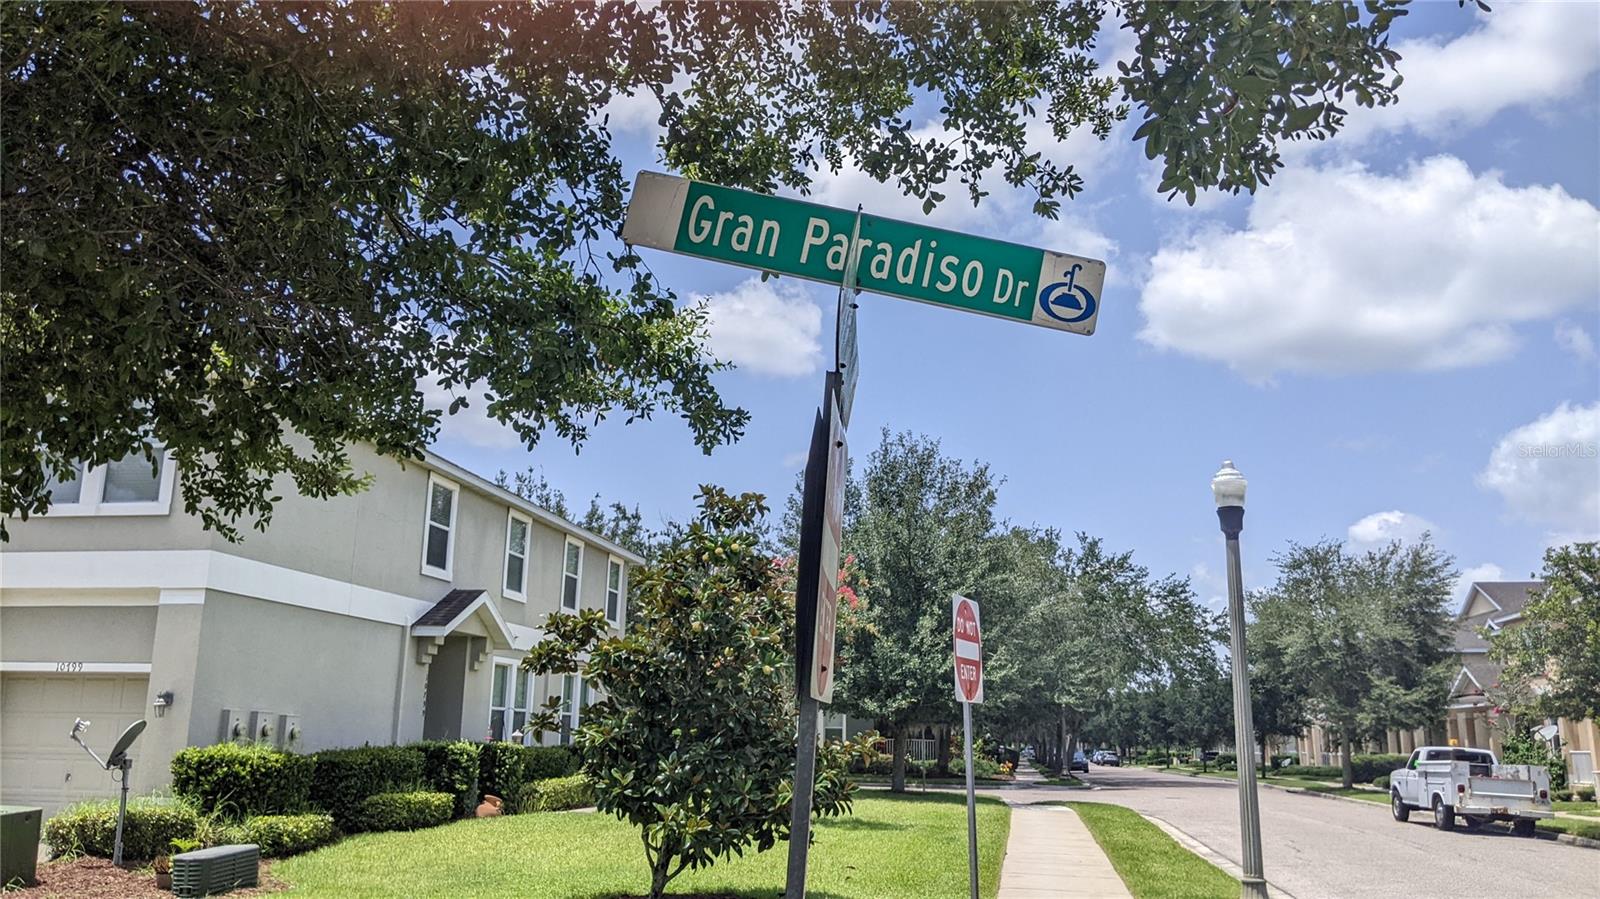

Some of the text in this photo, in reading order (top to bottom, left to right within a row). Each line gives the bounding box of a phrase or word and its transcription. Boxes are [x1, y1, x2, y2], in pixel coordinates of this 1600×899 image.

[688, 195, 1030, 307] Gran Paradiso Dr
[957, 617, 976, 637] DO NOT
[961, 664, 976, 680] ENTER
